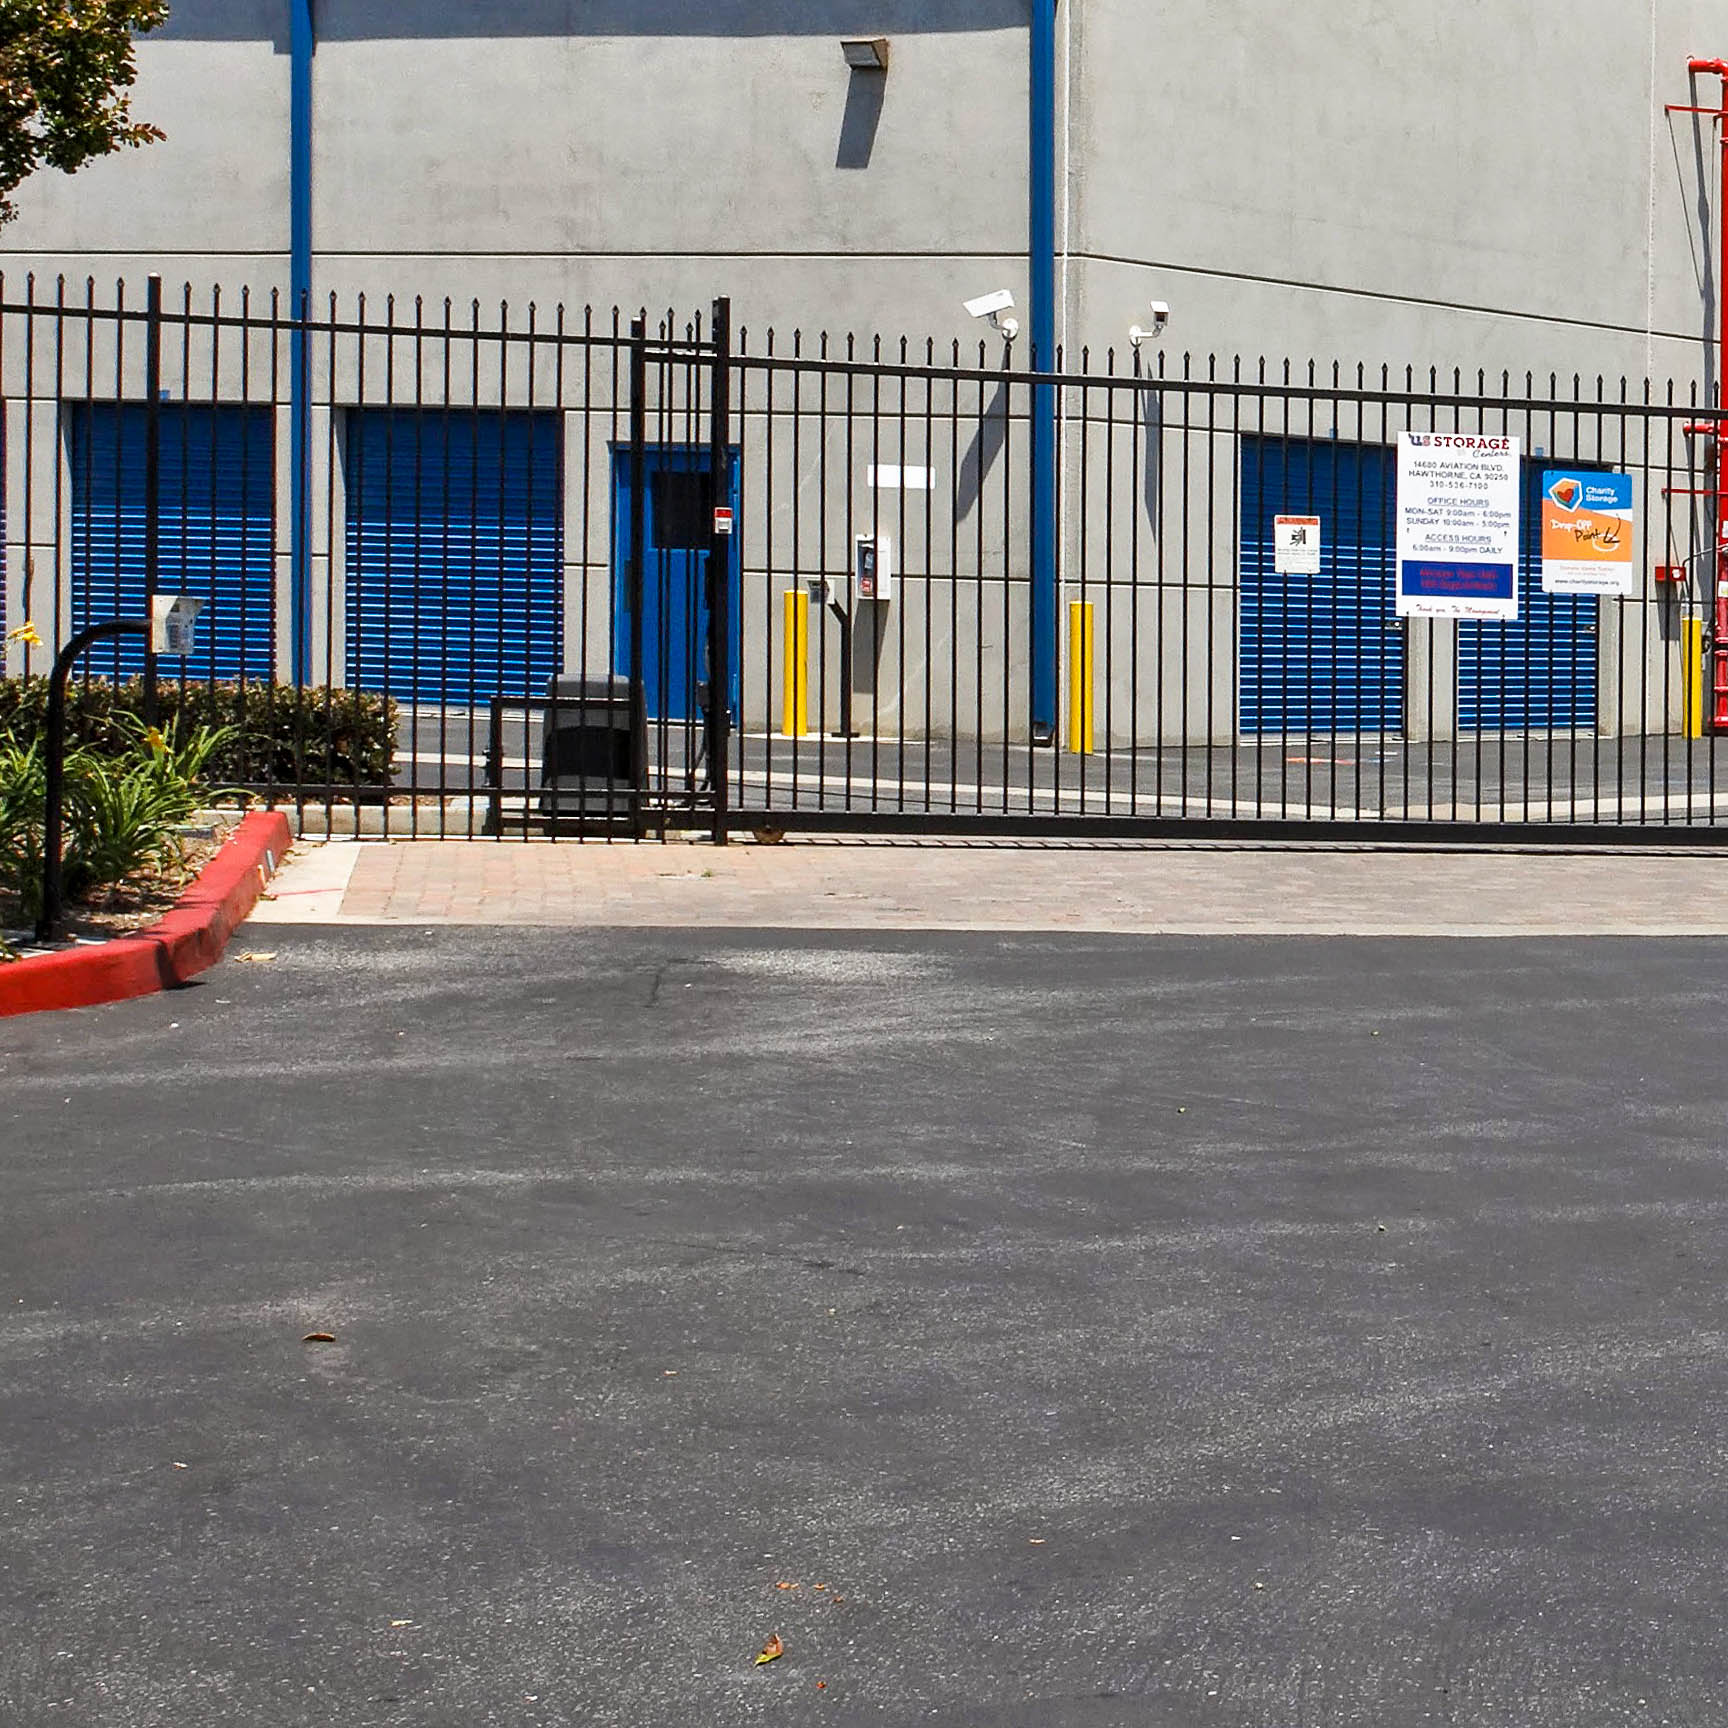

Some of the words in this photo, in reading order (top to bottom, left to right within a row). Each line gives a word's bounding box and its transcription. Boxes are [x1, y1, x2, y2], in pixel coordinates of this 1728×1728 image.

[1408, 433, 1431, 446] US
[1434, 436, 1510, 450] STORAGE
[1440, 461, 1479, 471] AVIATION
[1469, 472, 1482, 480] CA
[1585, 486, 1616, 496] Charity
[1427, 496, 1457, 506] OFFICE
[1460, 497, 1490, 507] HOURS
[1585, 495, 1619, 504] Storage
[1406, 517, 1440, 525] SUNDAY
[1425, 533, 1460, 542] ACCESS
[1461, 535, 1492, 544] HOURS
[1479, 546, 1503, 554] DAILY
